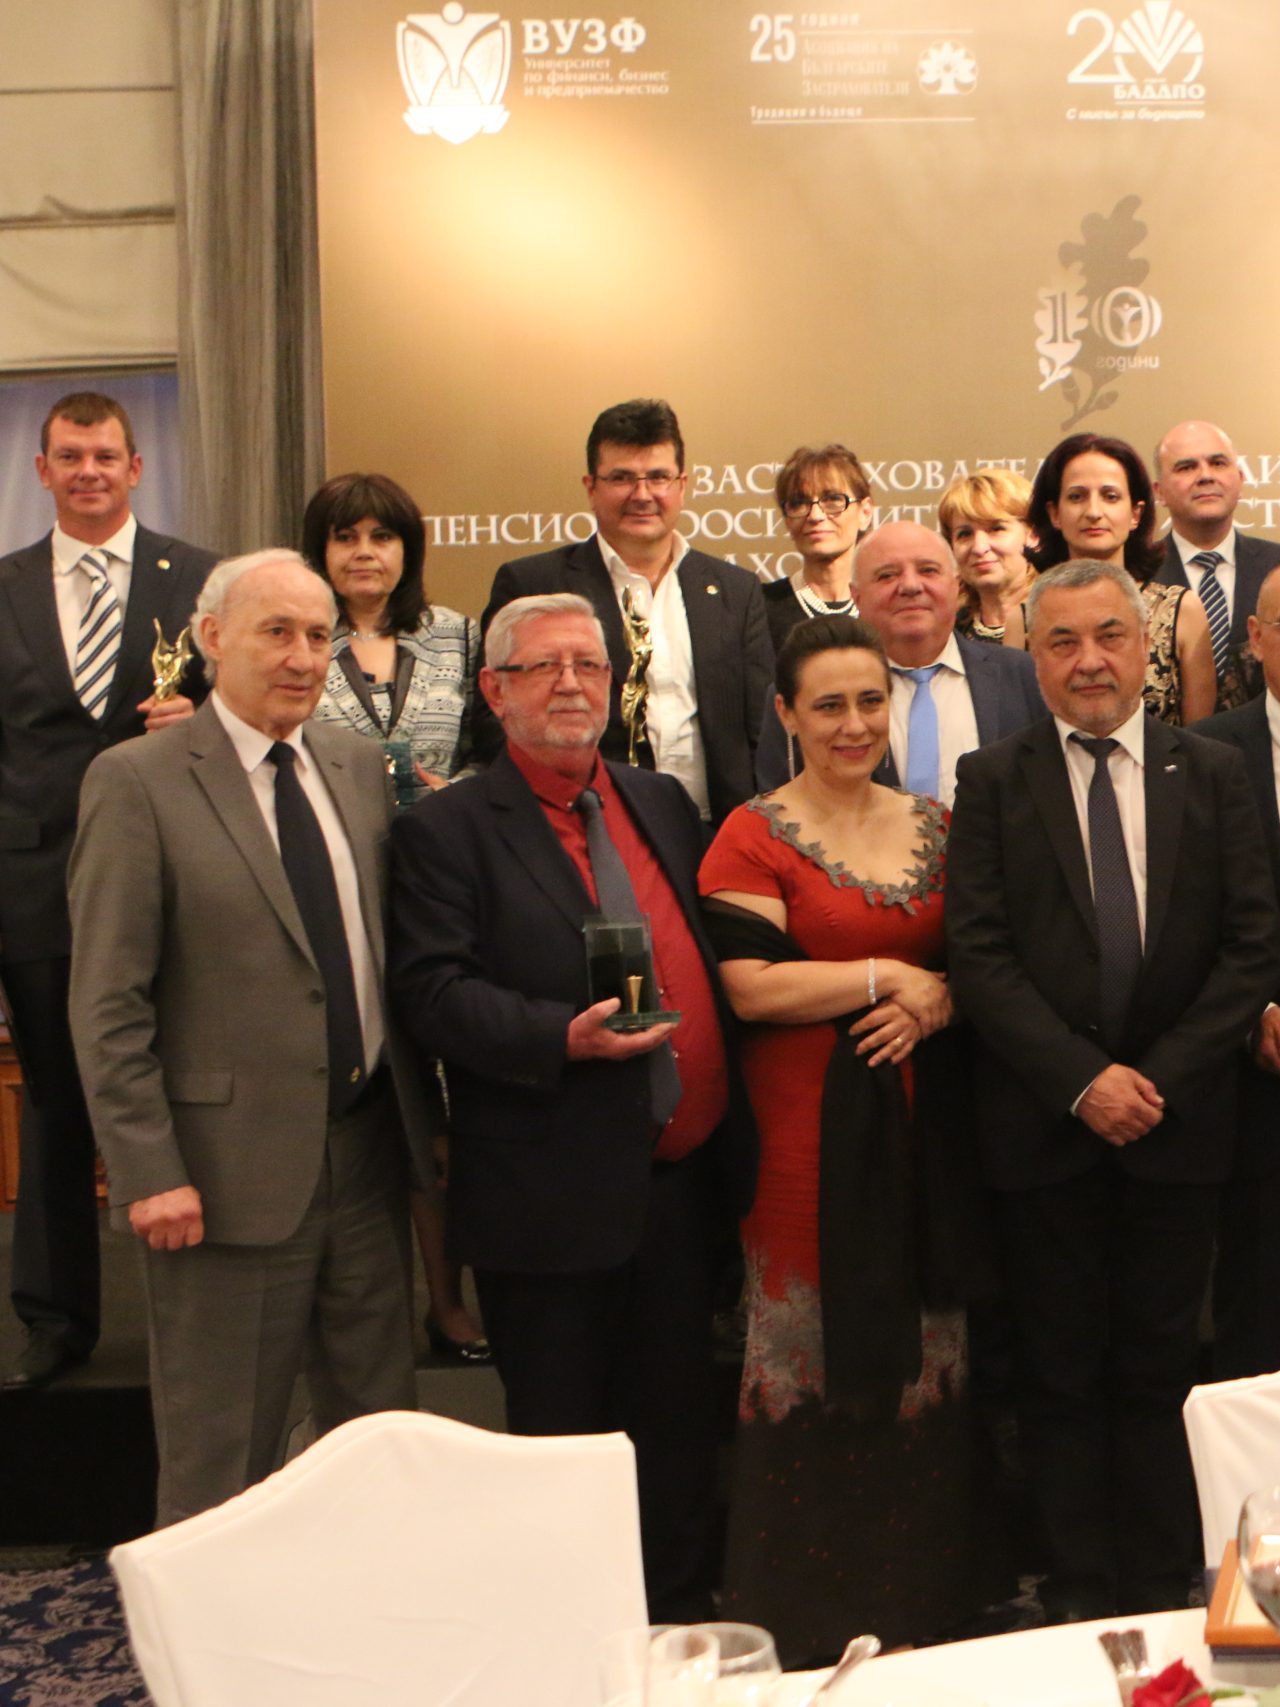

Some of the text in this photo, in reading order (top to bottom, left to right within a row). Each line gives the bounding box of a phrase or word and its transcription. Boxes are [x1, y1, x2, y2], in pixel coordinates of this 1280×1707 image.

[520, 17, 647, 55] ВУЗФ
[748, 13, 797, 63] 25
[523, 71, 543, 83] по
